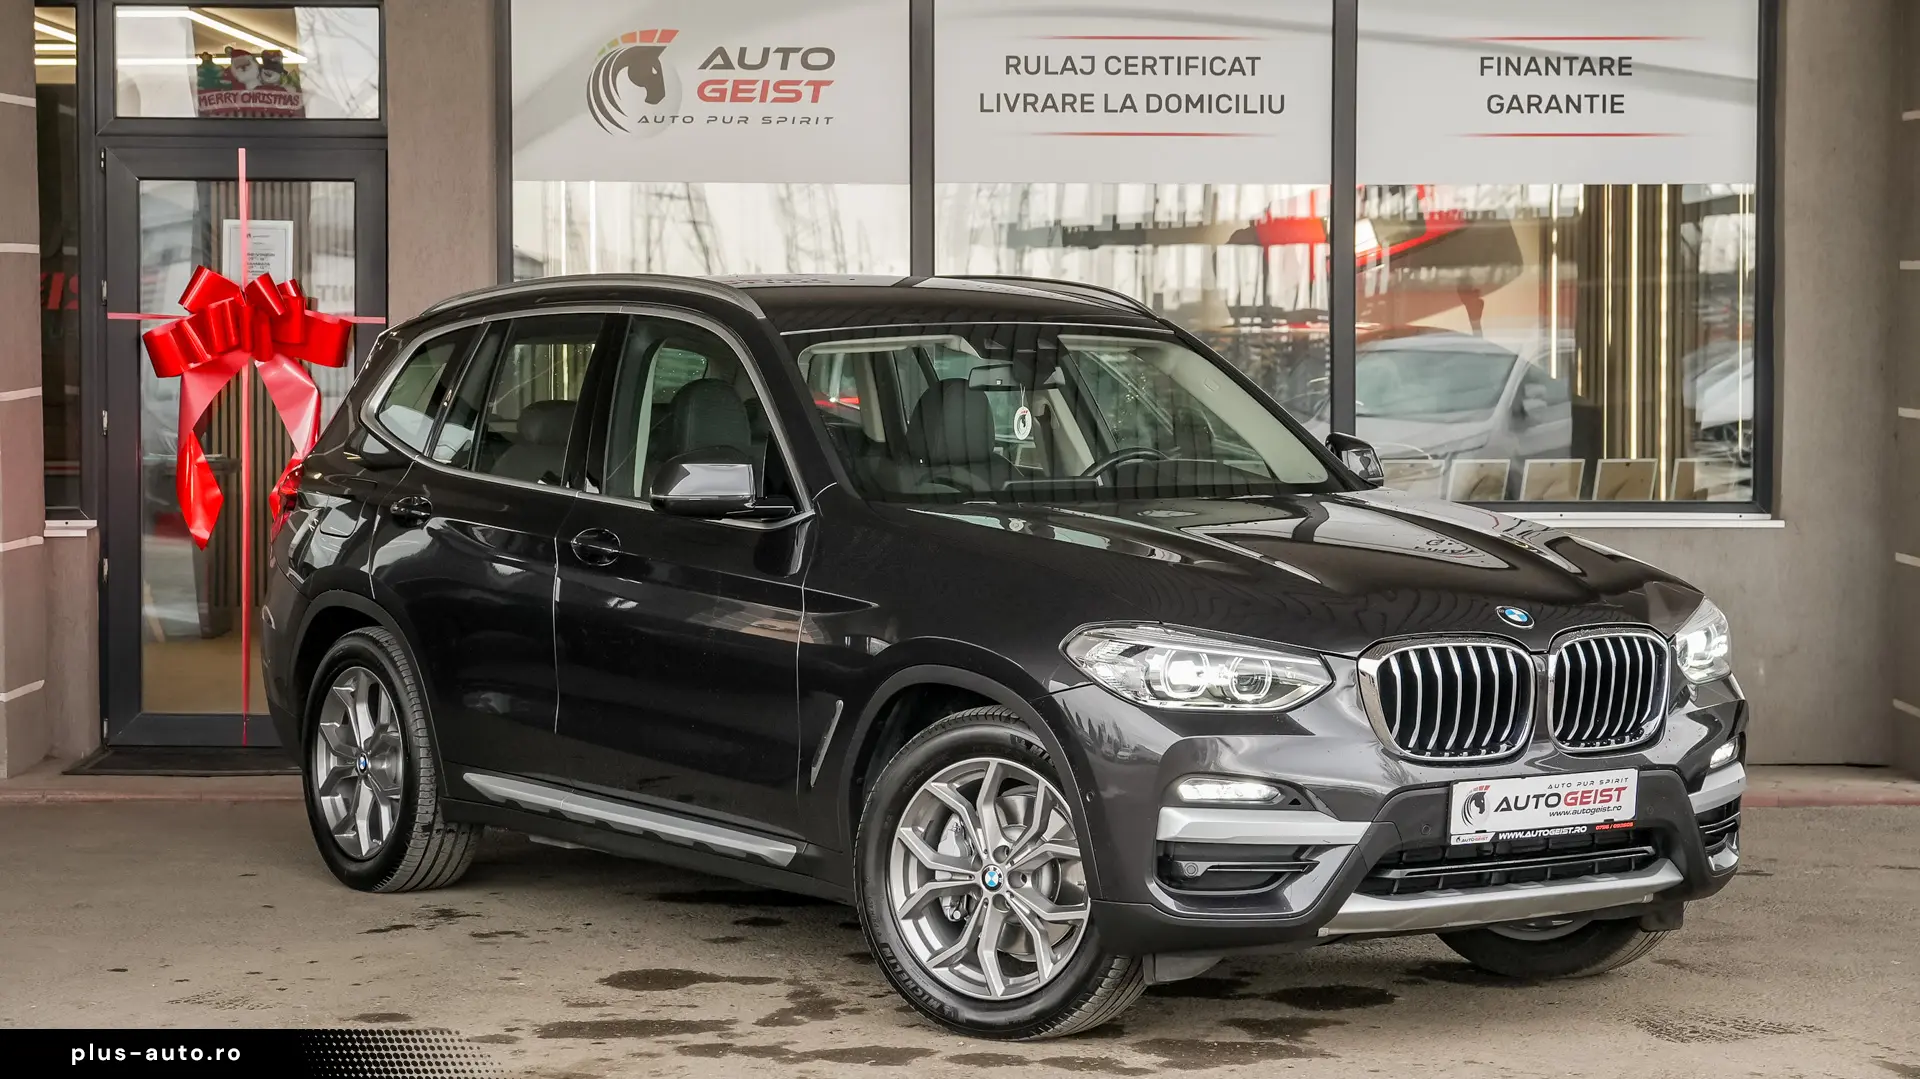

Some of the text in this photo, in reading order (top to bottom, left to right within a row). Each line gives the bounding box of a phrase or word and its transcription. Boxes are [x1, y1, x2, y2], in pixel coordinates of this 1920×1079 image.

[697, 46, 836, 71] AUTO
[1005, 55, 1262, 76] RULAJ CERTIFICAT
[1480, 56, 1633, 76] FINANTARE
[199, 91, 300, 107] MERRY CHRISTMAS
[697, 79, 835, 104] GEIST
[979, 93, 1285, 114] LIVRARE LA DOMICILIU
[1486, 94, 1625, 114] GARANTIE
[637, 115, 835, 125] AUTO PUR SPIRIT
[1548, 782, 1573, 790] AUTO
[1599, 777, 1629, 786] SPIRIT
[1549, 805, 1622, 818] www.autogeist.ro
[1498, 825, 1587, 841] WWW.AUTOGEIST.RO
[881, 945, 942, 1010] MICHELIN
